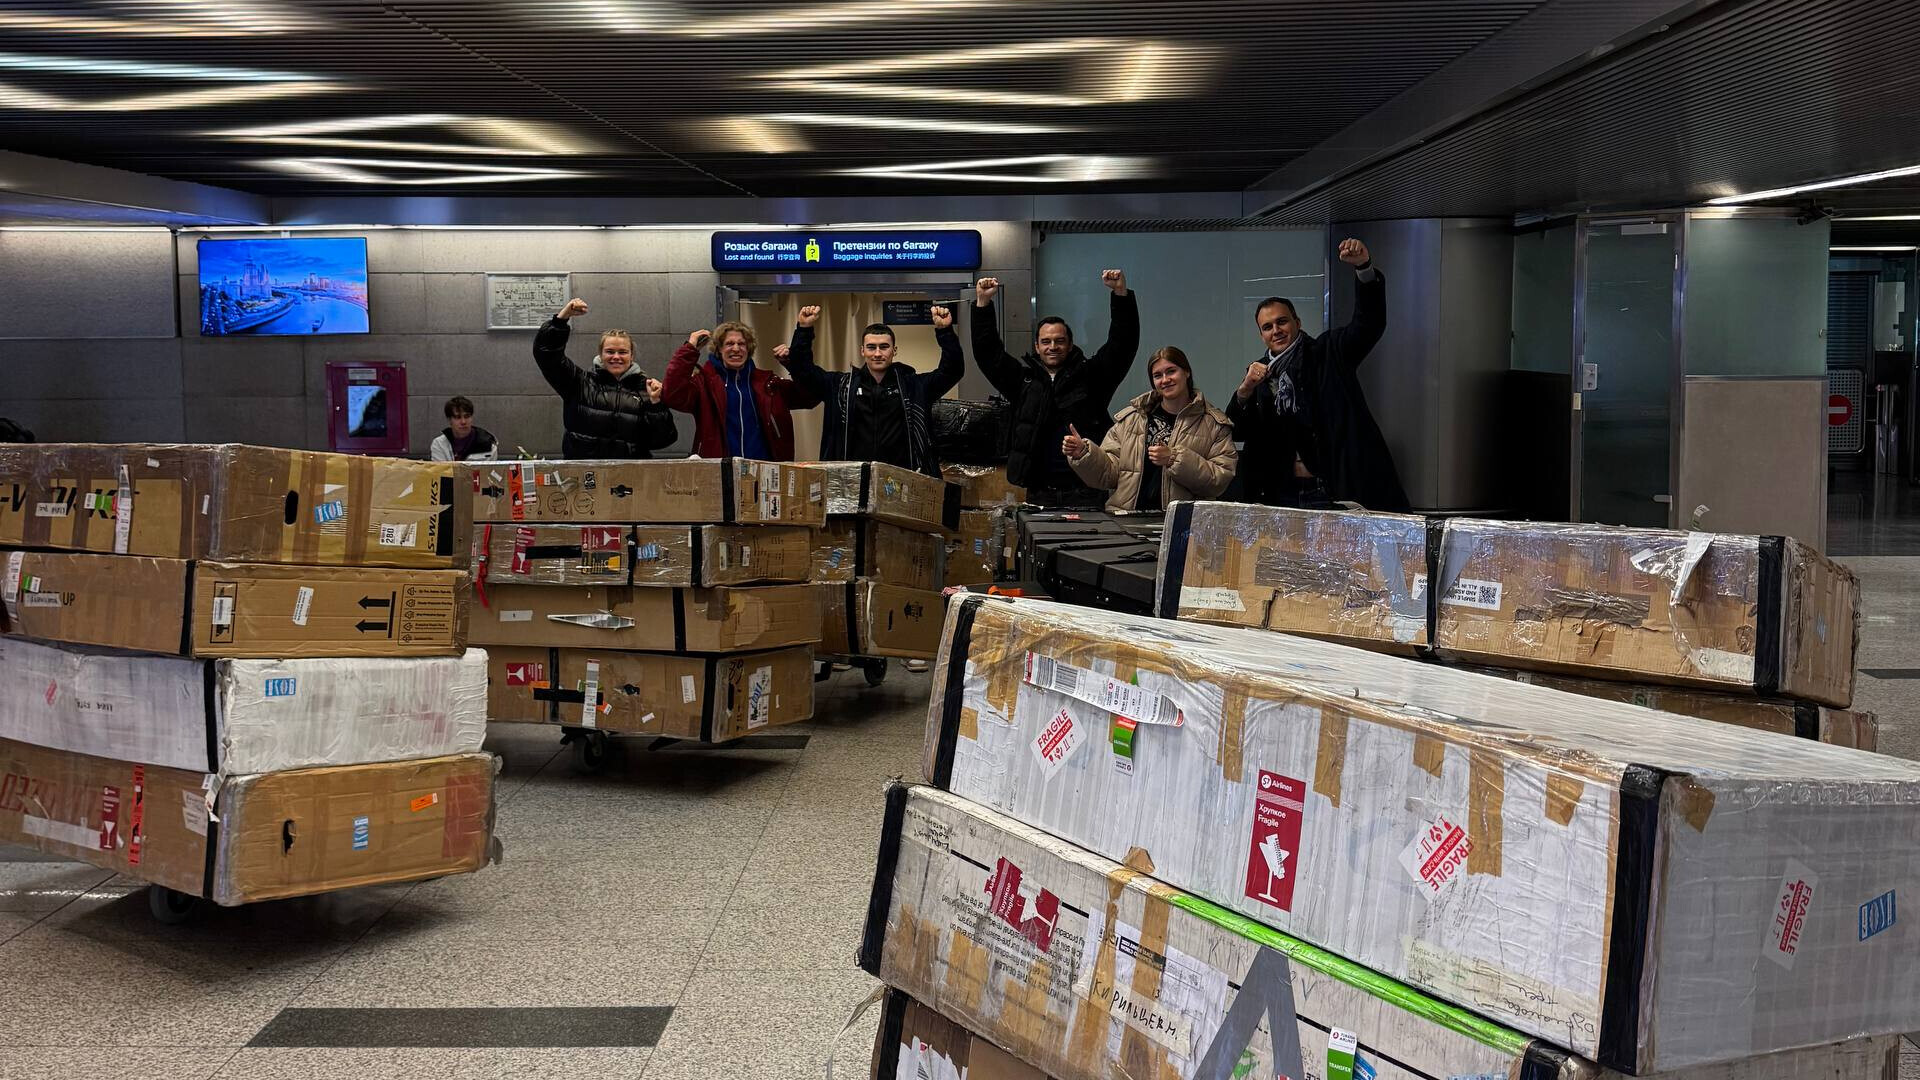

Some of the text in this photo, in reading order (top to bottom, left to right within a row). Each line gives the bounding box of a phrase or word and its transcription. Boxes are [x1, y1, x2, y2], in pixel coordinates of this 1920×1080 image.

[724, 242, 798, 251] Розыск багажа
[833, 242, 885, 251] Претензии
[903, 241, 938, 251] багажу
[385, 528, 394, 544] 280
[63, 591, 75, 606] UP
[1037, 709, 1068, 749] FRAGILE
[1272, 780, 1293, 792] Airlines
[1258, 803, 1286, 819] Хрупкое
[1257, 814, 1279, 829] Fragile
[1444, 830, 1462, 851] HANDLE
[1428, 838, 1474, 891] FRAGILE
[998, 882, 1012, 913] Хрупкое
[1004, 894, 1015, 918] Fragile
[1786, 886, 1812, 955] FRAGILE
[993, 958, 1016, 977] DEALER
[1329, 1062, 1351, 1072] TRANSFER
